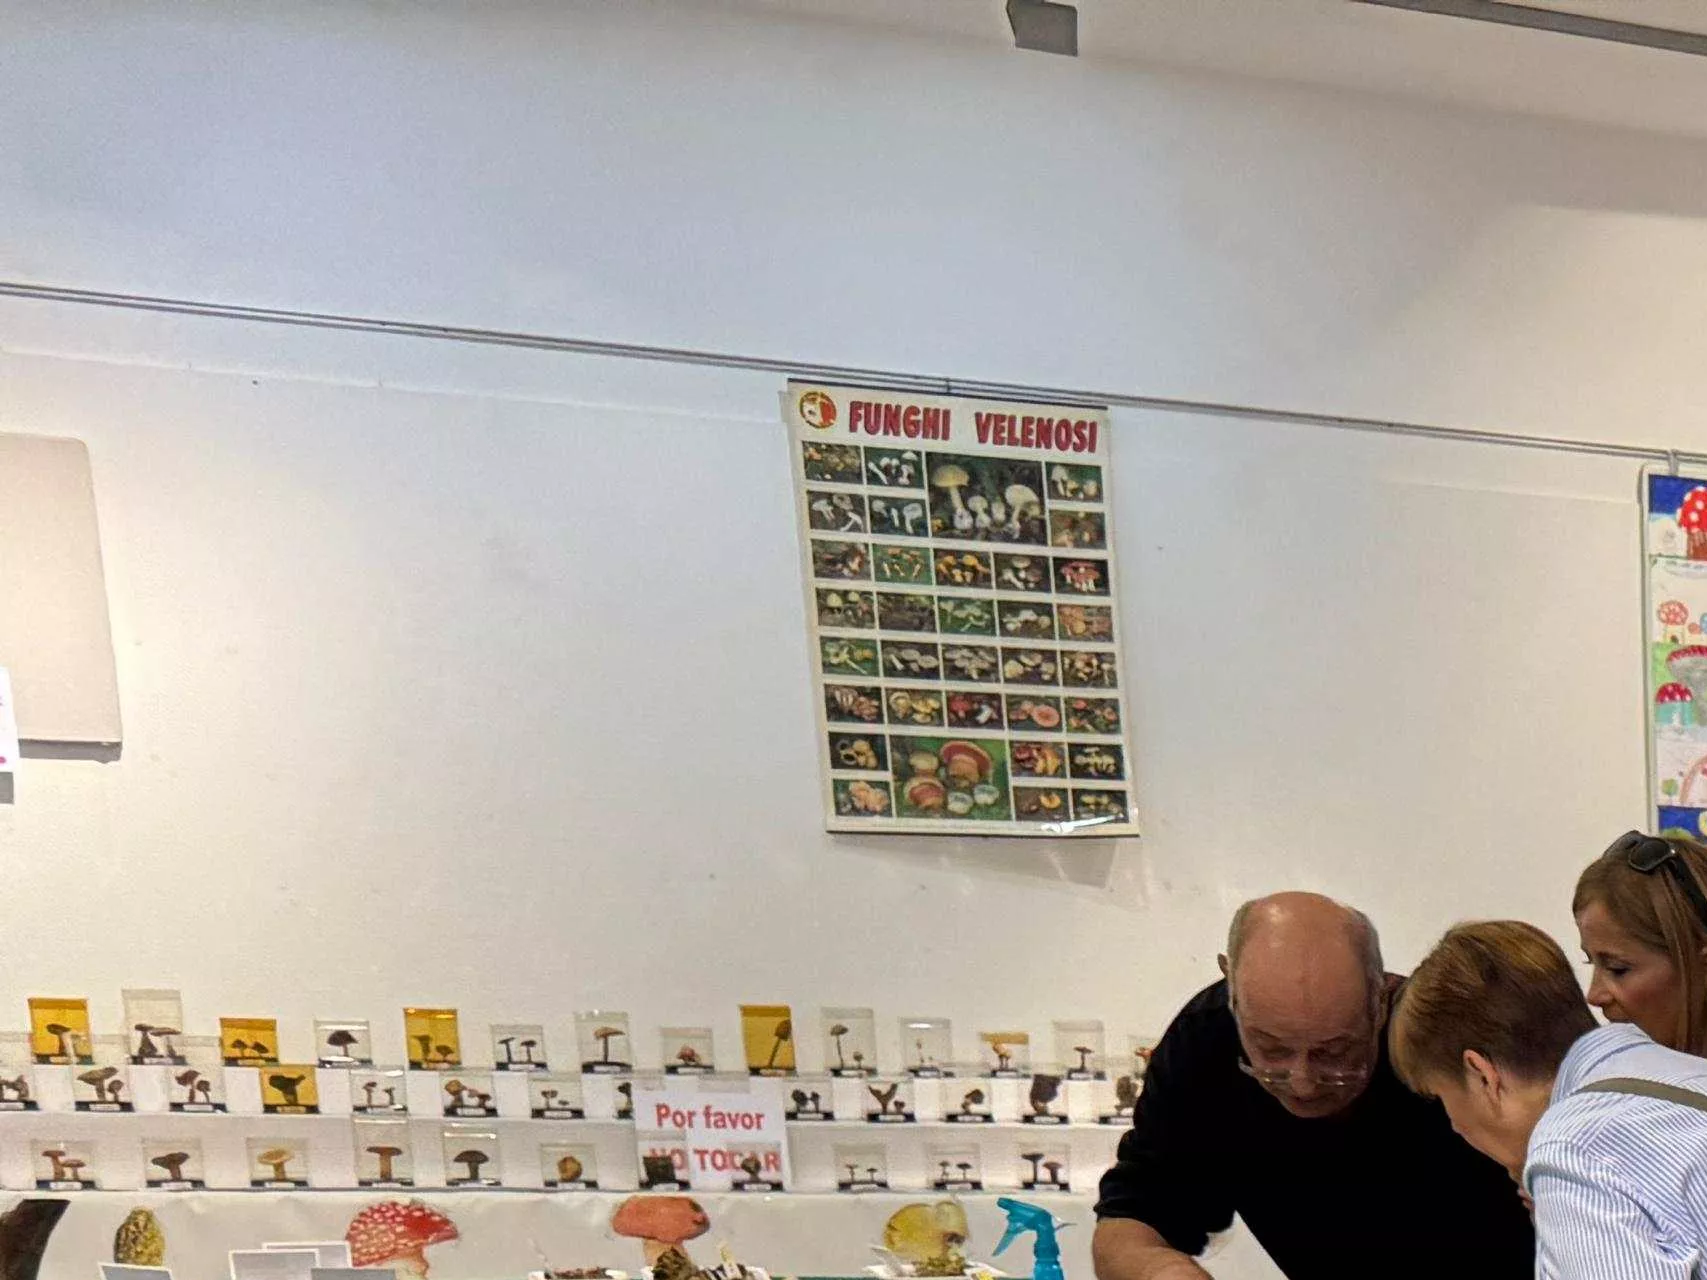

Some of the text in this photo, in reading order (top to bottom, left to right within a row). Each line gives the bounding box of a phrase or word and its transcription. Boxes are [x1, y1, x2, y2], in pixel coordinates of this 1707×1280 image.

[849, 401, 1098, 453] FUNGHI VELENOSI
[655, 1103, 765, 1130] Por favor
